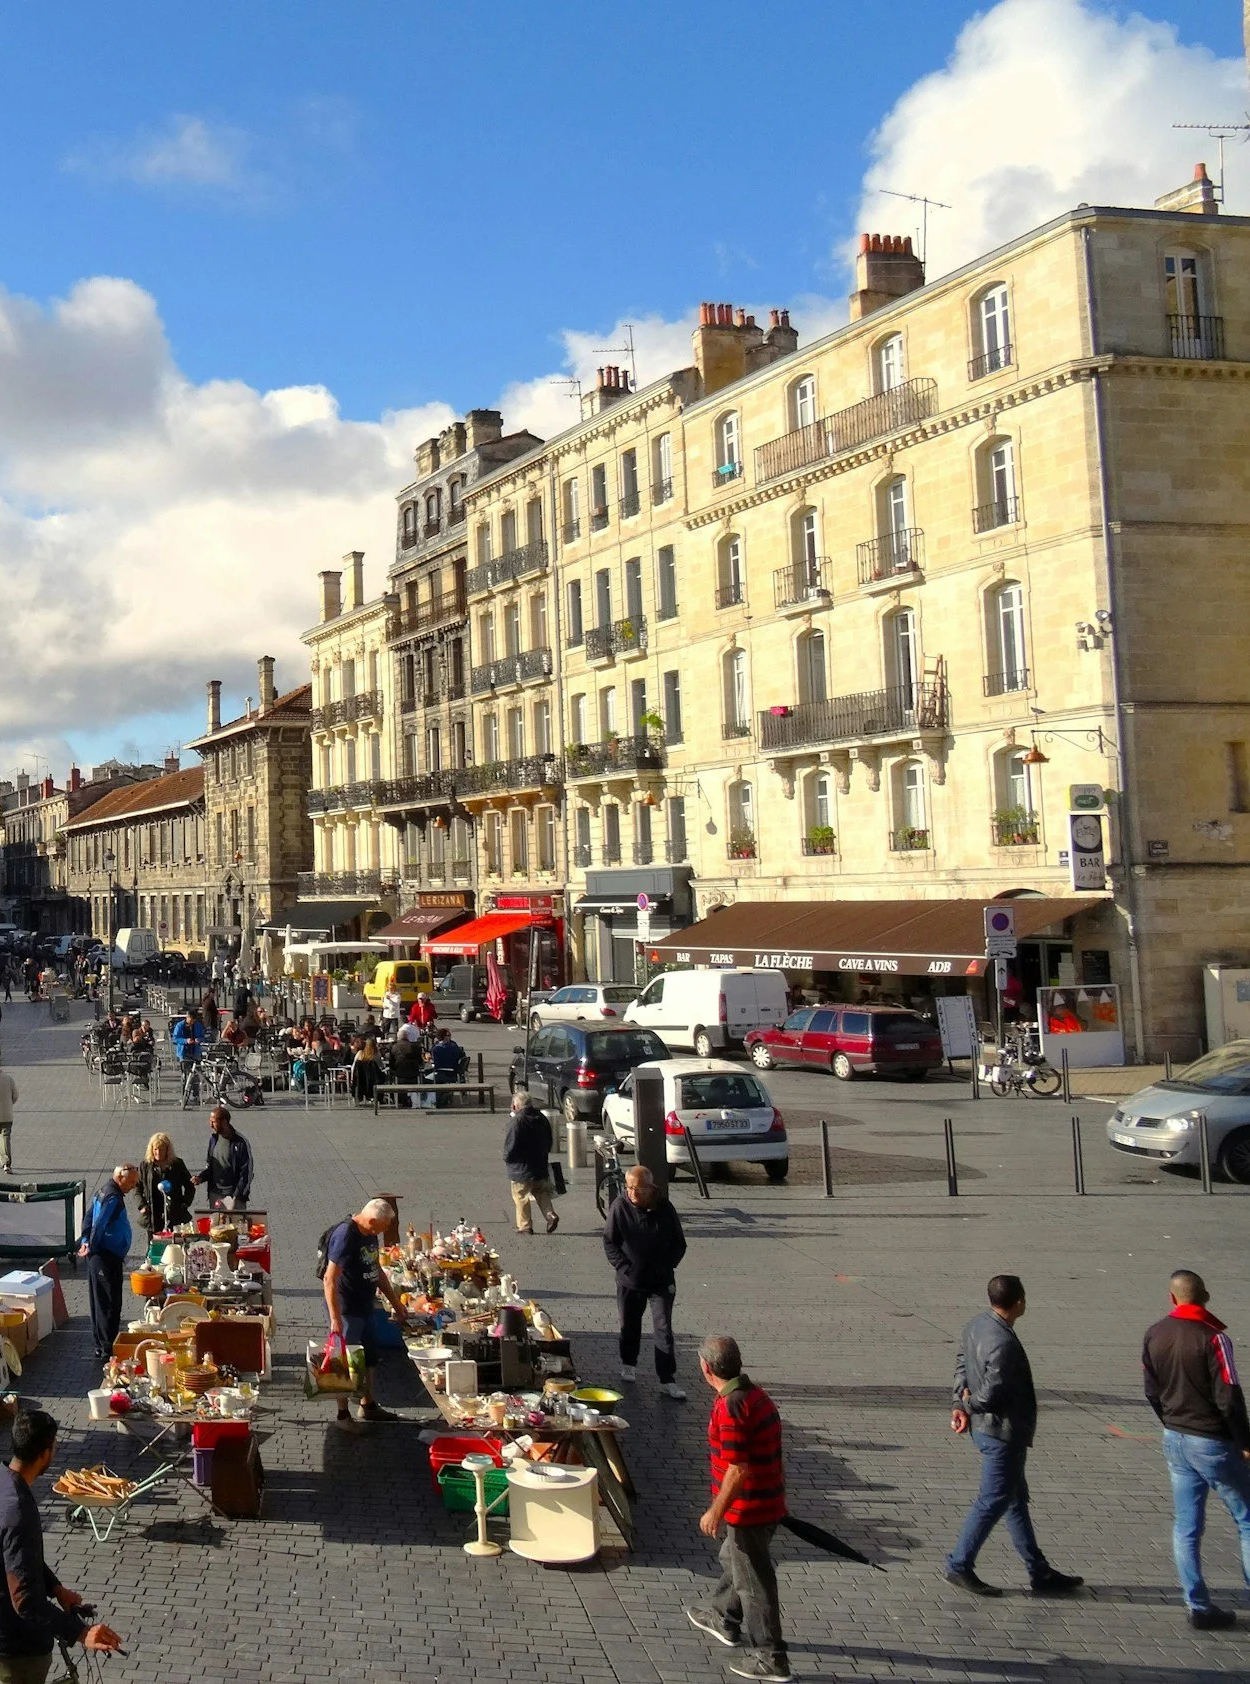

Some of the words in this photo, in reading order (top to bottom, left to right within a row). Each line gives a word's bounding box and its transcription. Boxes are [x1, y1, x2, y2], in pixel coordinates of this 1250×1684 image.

[1079, 858, 1100, 868] BAR
[676, 952, 690, 962] BAR
[710, 953, 734, 964] TAPAS
[755, 954, 770, 968] LA
[770, 952, 813, 970] FLÈCHE
[838, 958, 865, 970] CAVE
[865, 959, 874, 971] A
[874, 960, 898, 972] VINS
[928, 961, 952, 973] ADB
